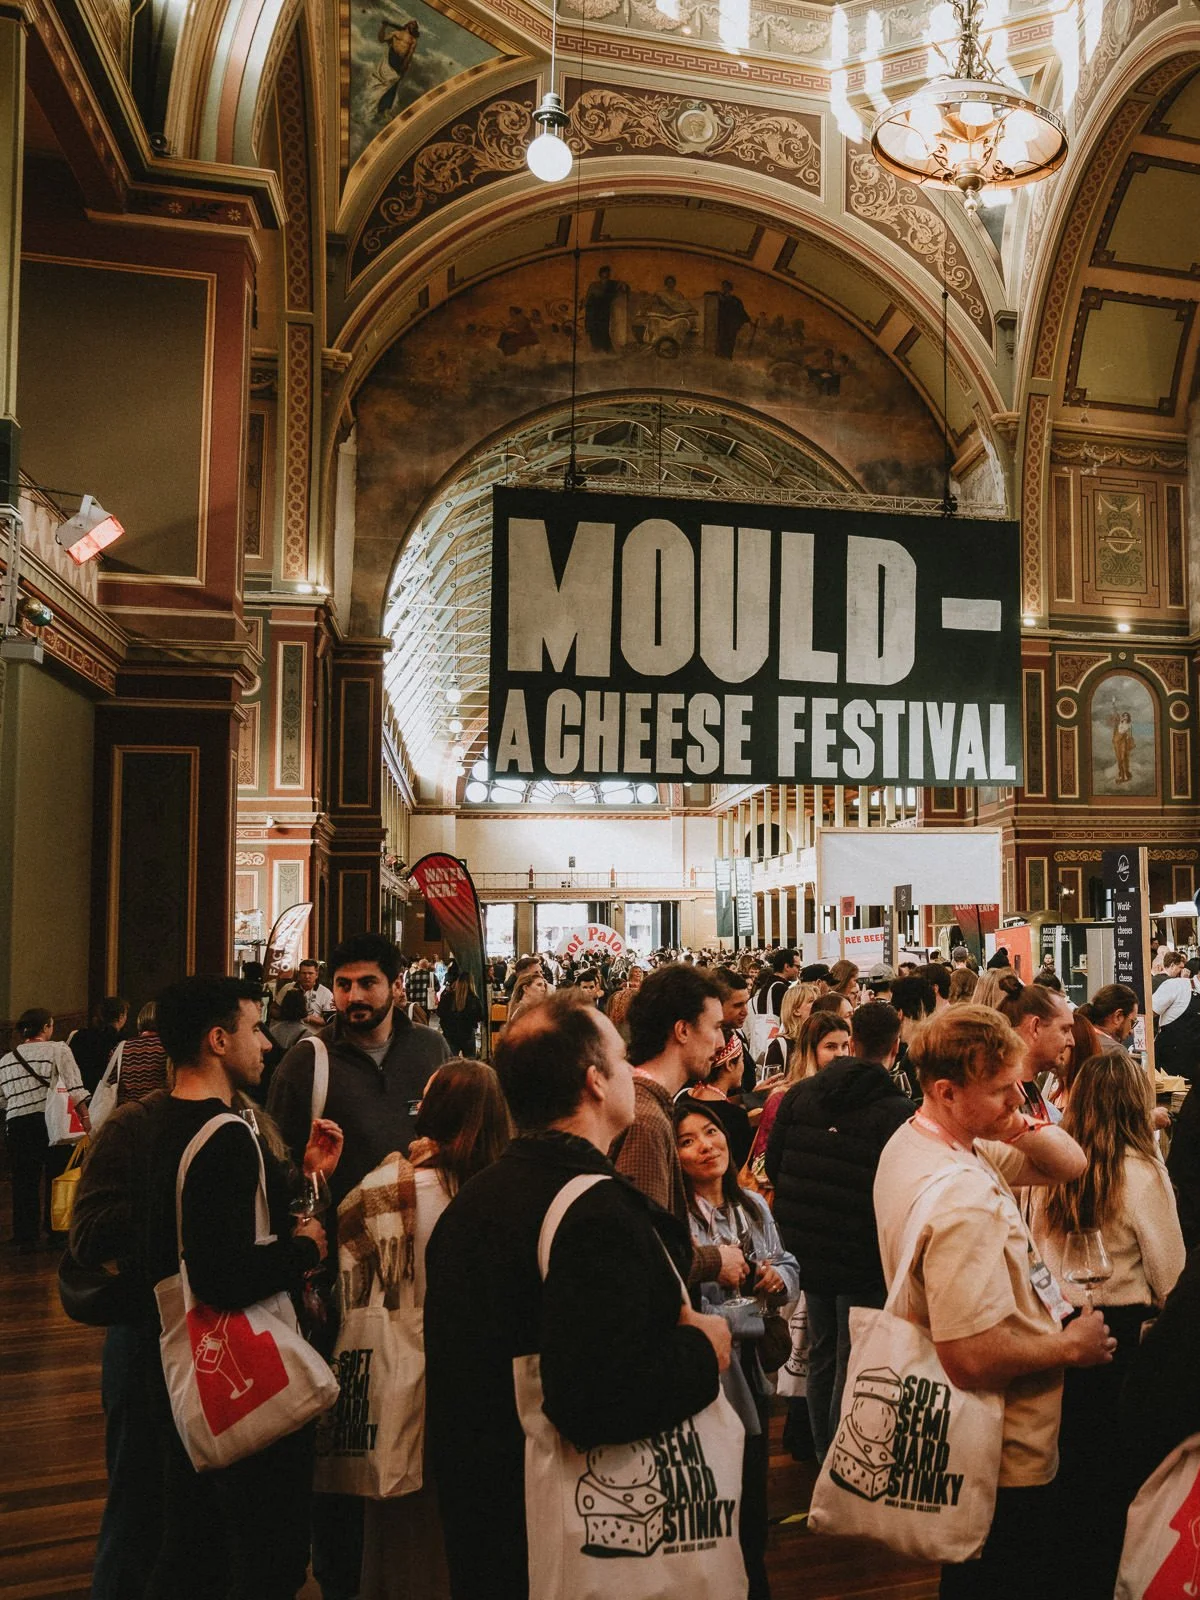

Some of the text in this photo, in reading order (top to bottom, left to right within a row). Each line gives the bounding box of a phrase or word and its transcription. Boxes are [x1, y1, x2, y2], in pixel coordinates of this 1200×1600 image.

[508, 518, 917, 686] MOULD
[495, 688, 1017, 781] A CHEESE FESTIVAL
[567, 926, 622, 954] ot Palo
[1117, 926, 1133, 934] cheeses
[1118, 952, 1129, 960] every
[1119, 974, 1133, 982] cheese
[903, 1375, 952, 1410] SOFT
[896, 1405, 951, 1441] SEMI
[651, 1431, 706, 1466] SEMI
[892, 1435, 950, 1473] HARD
[658, 1465, 718, 1504] HARD
[887, 1465, 964, 1506] STINKY
[662, 1500, 736, 1543] STINKY
